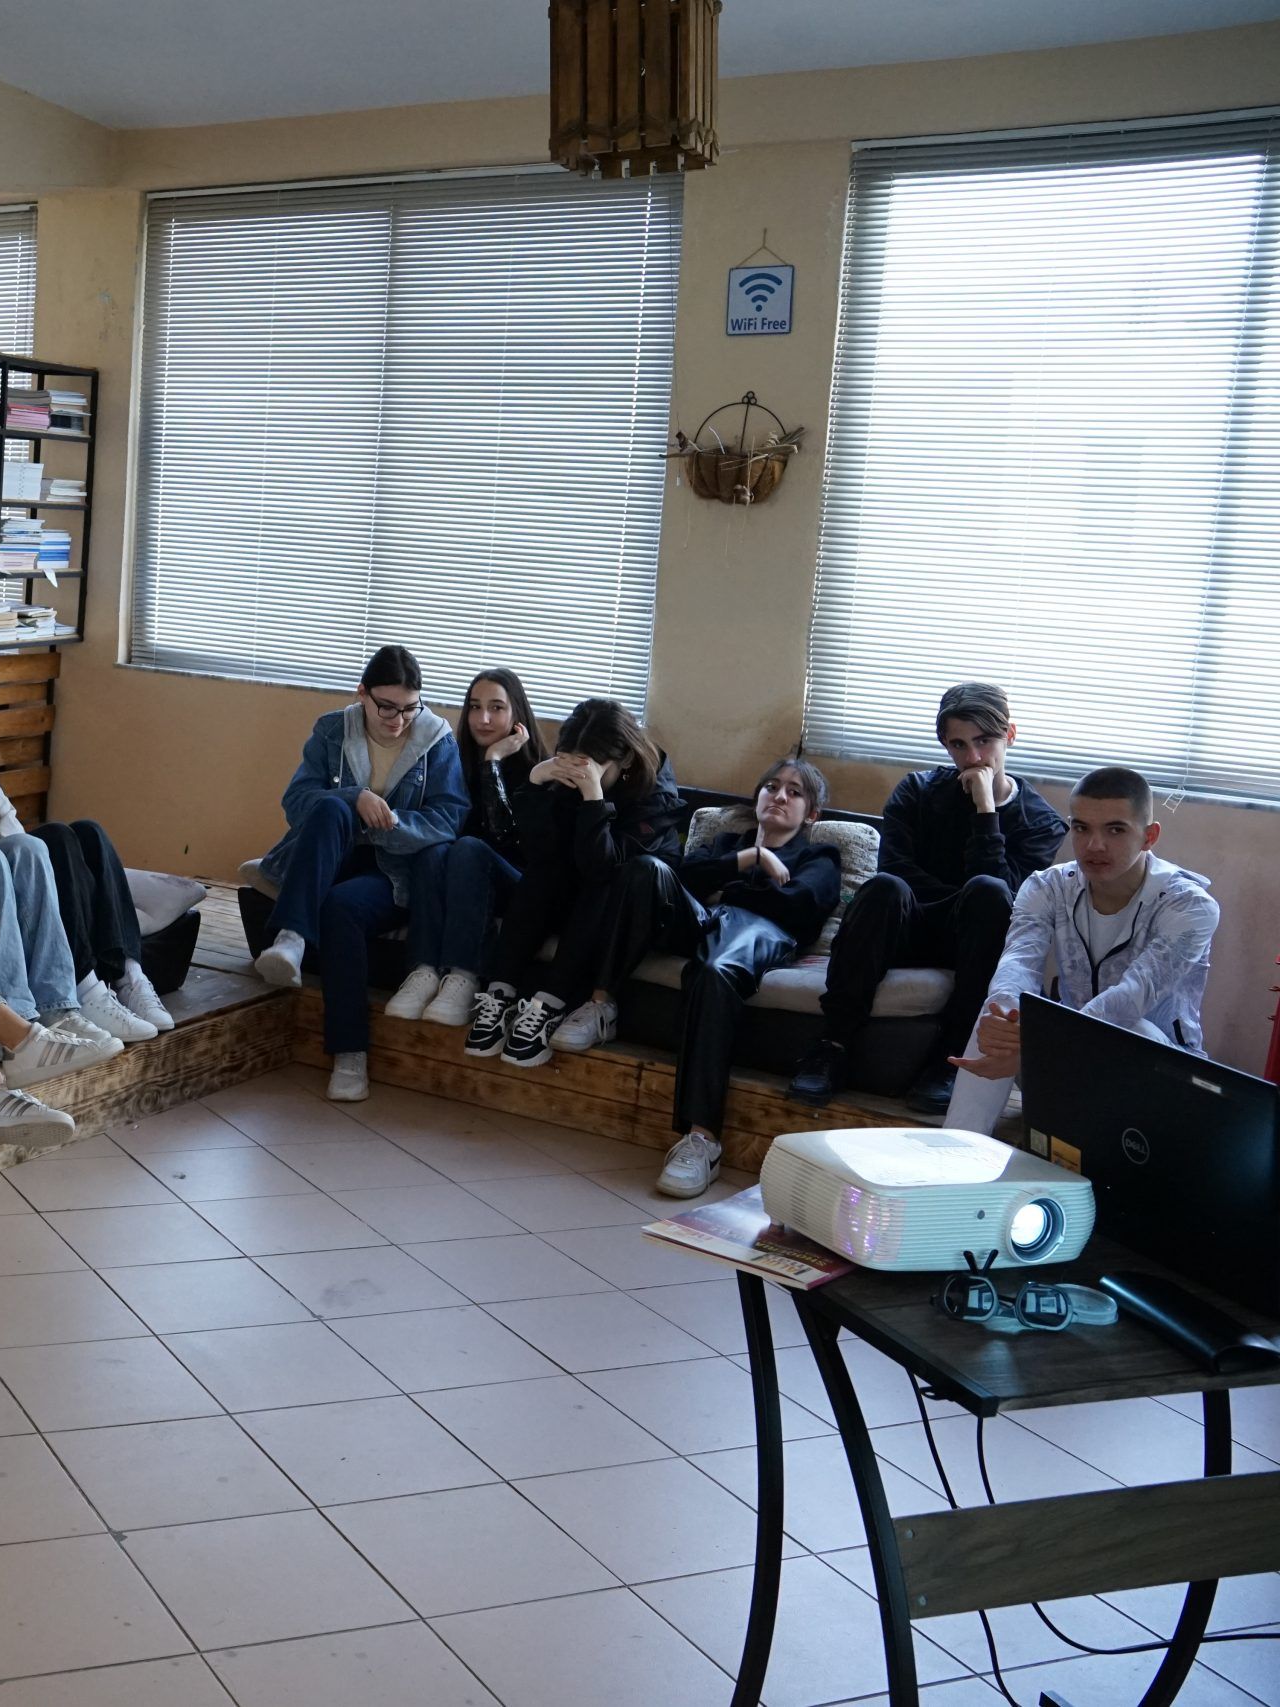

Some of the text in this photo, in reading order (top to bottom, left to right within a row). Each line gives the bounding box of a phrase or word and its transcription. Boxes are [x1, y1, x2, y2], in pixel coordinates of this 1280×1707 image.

[731, 317, 787, 331] WiFi Free
[1126, 1138, 1145, 1154] DELL
